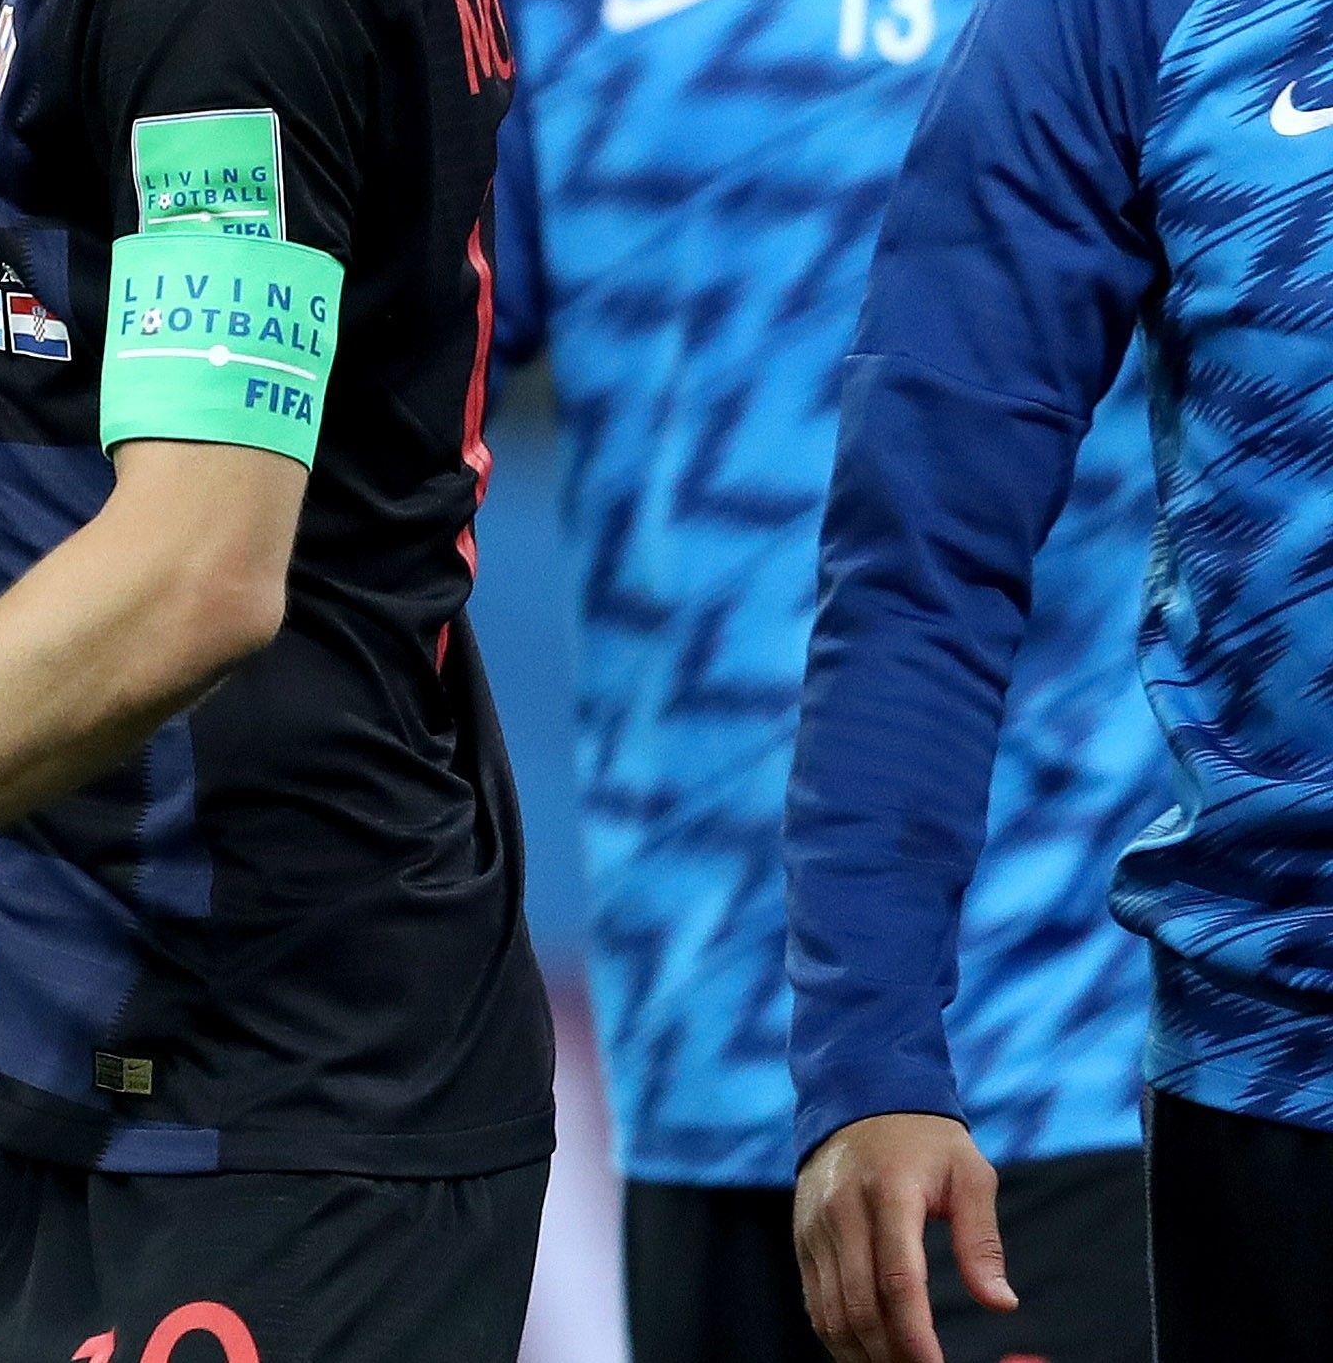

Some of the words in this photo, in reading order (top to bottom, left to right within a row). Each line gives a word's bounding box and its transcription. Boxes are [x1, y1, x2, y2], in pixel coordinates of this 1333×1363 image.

[145, 170, 267, 190] LIVING
[223, 222, 273, 239] FIFA
[124, 274, 326, 324] LIVING
[244, 377, 312, 425] FIFA
